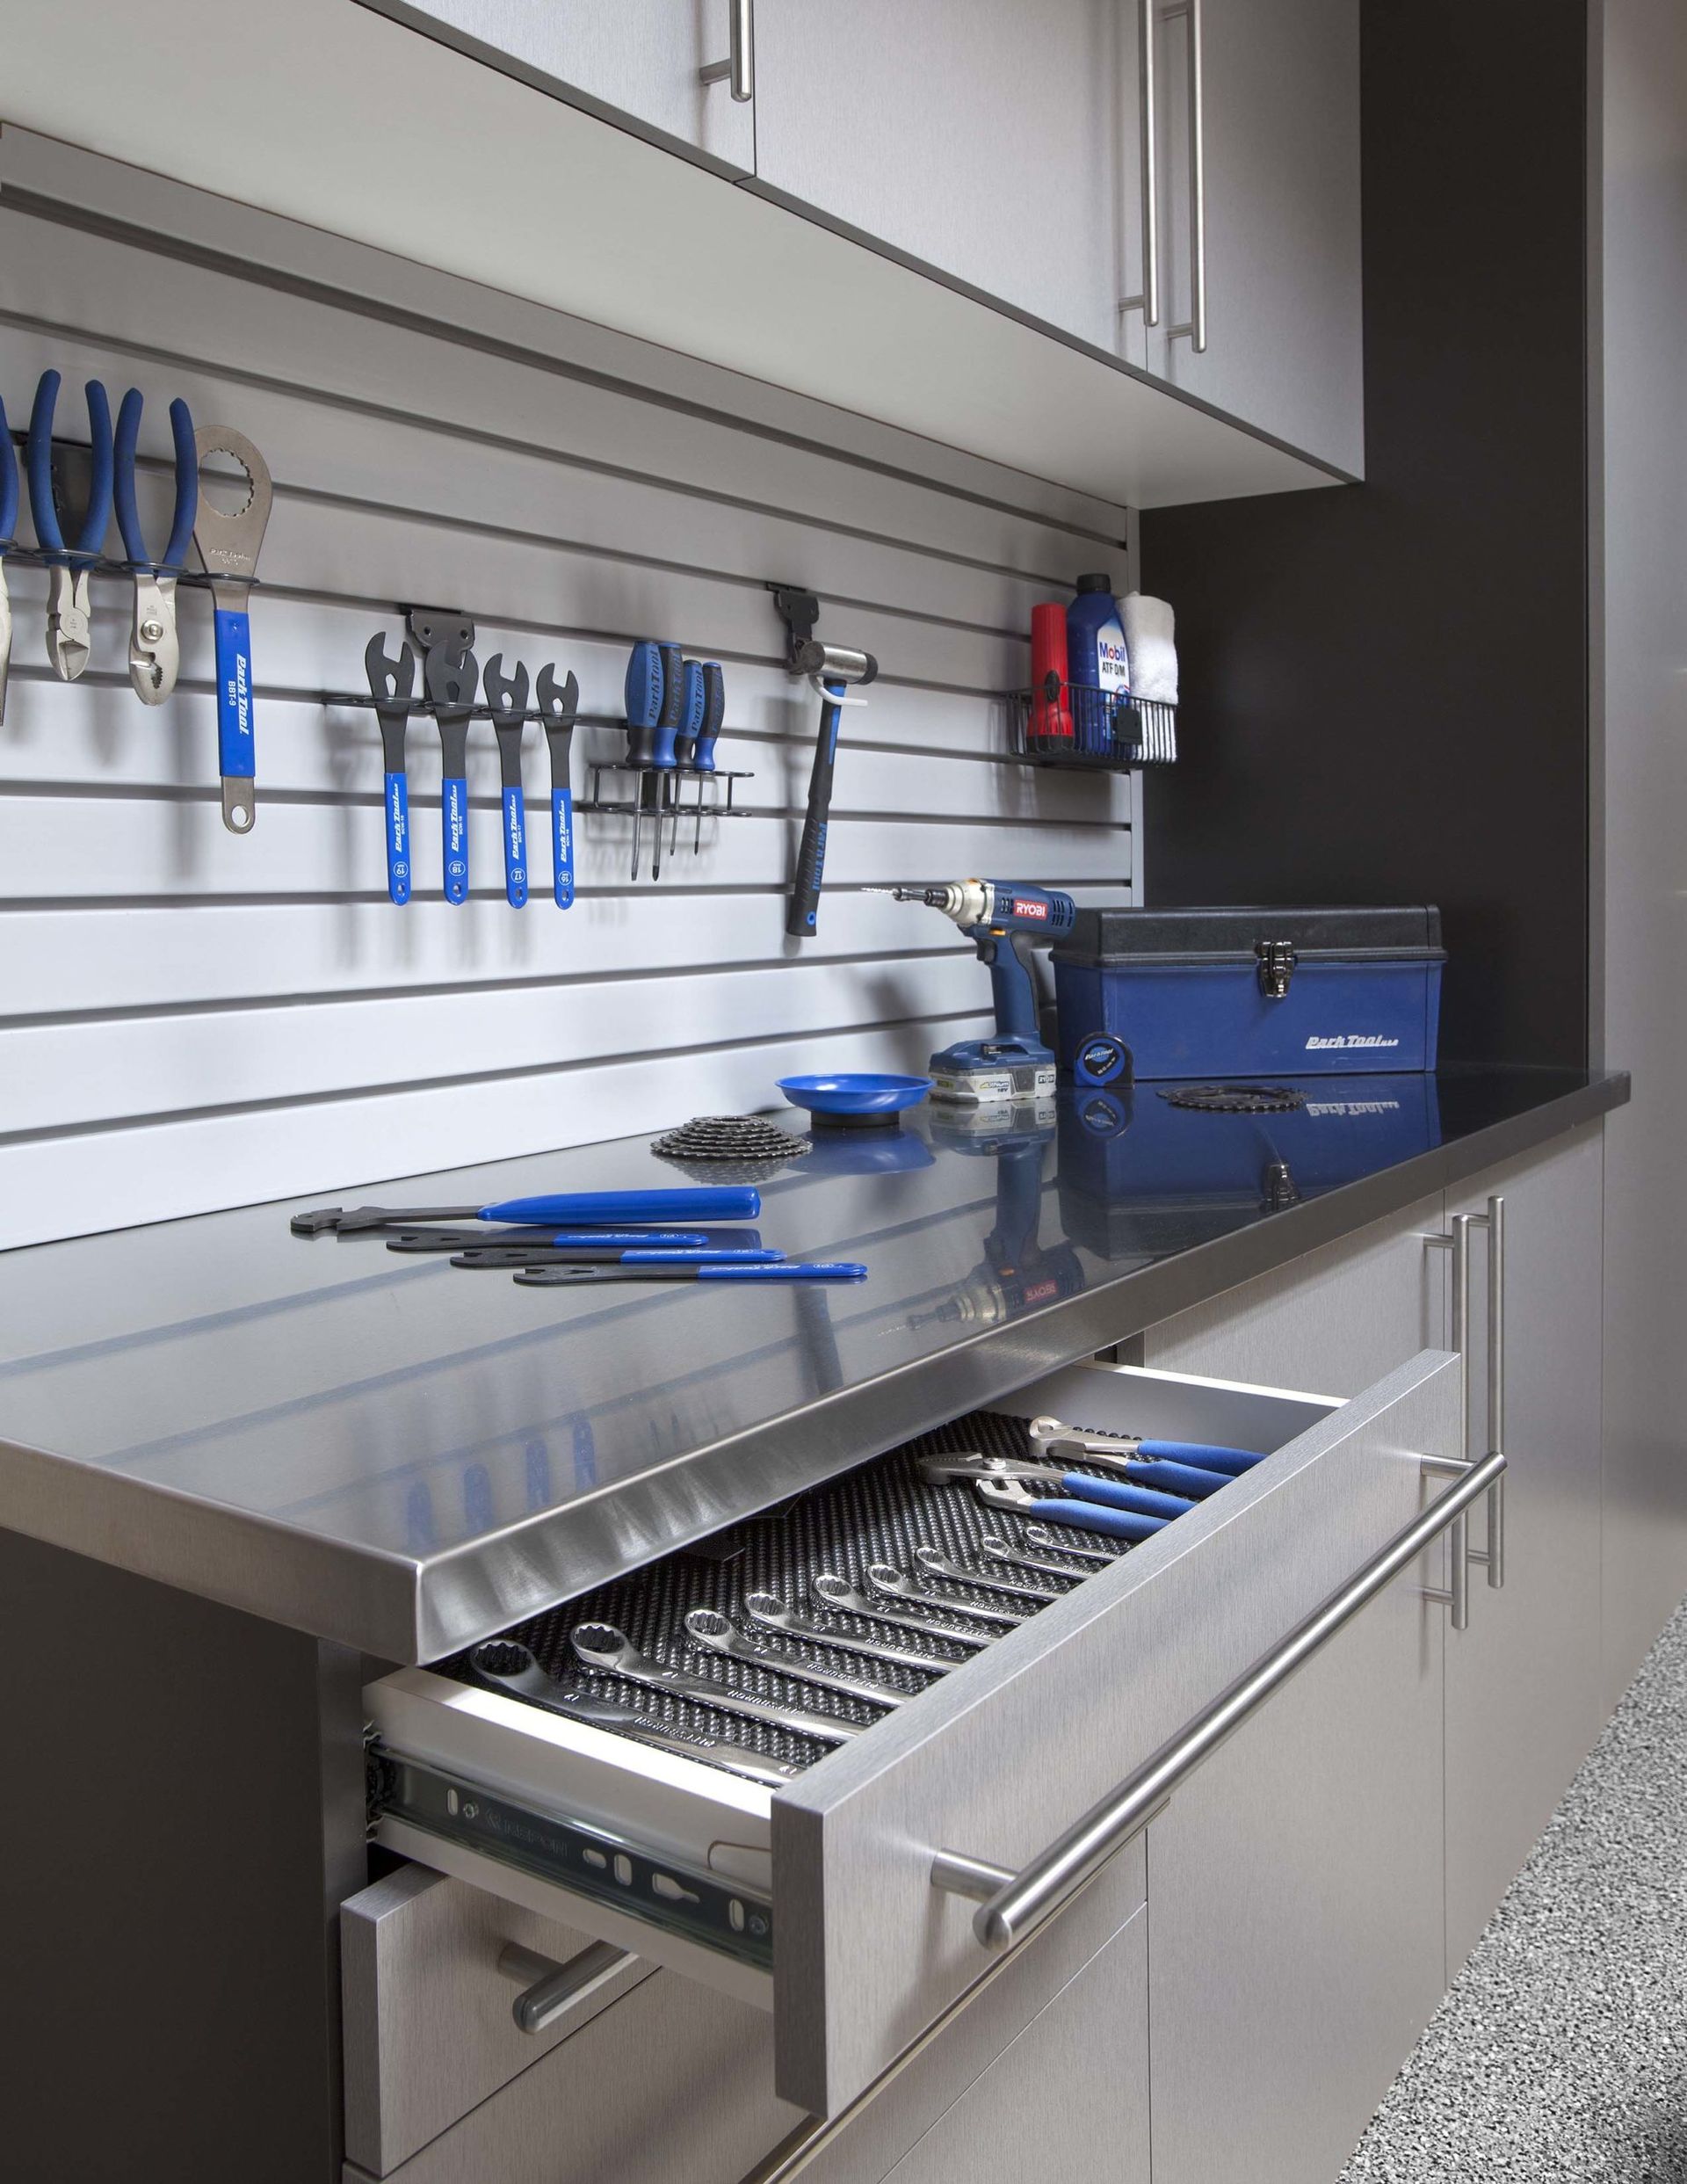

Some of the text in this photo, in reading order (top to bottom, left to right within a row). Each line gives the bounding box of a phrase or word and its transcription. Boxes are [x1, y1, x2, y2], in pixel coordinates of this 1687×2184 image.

[1099, 642, 1126, 662] Mobil
[1102, 661, 1112, 674] ATF
[1016, 903, 1046, 917] RYOBI
[1306, 1036, 1345, 1049] Park
[1347, 1034, 1383, 1048] Tool
[865, 1637, 936, 1659] PITTSBURGH
[807, 1663, 880, 1689] PITTSBURGH
